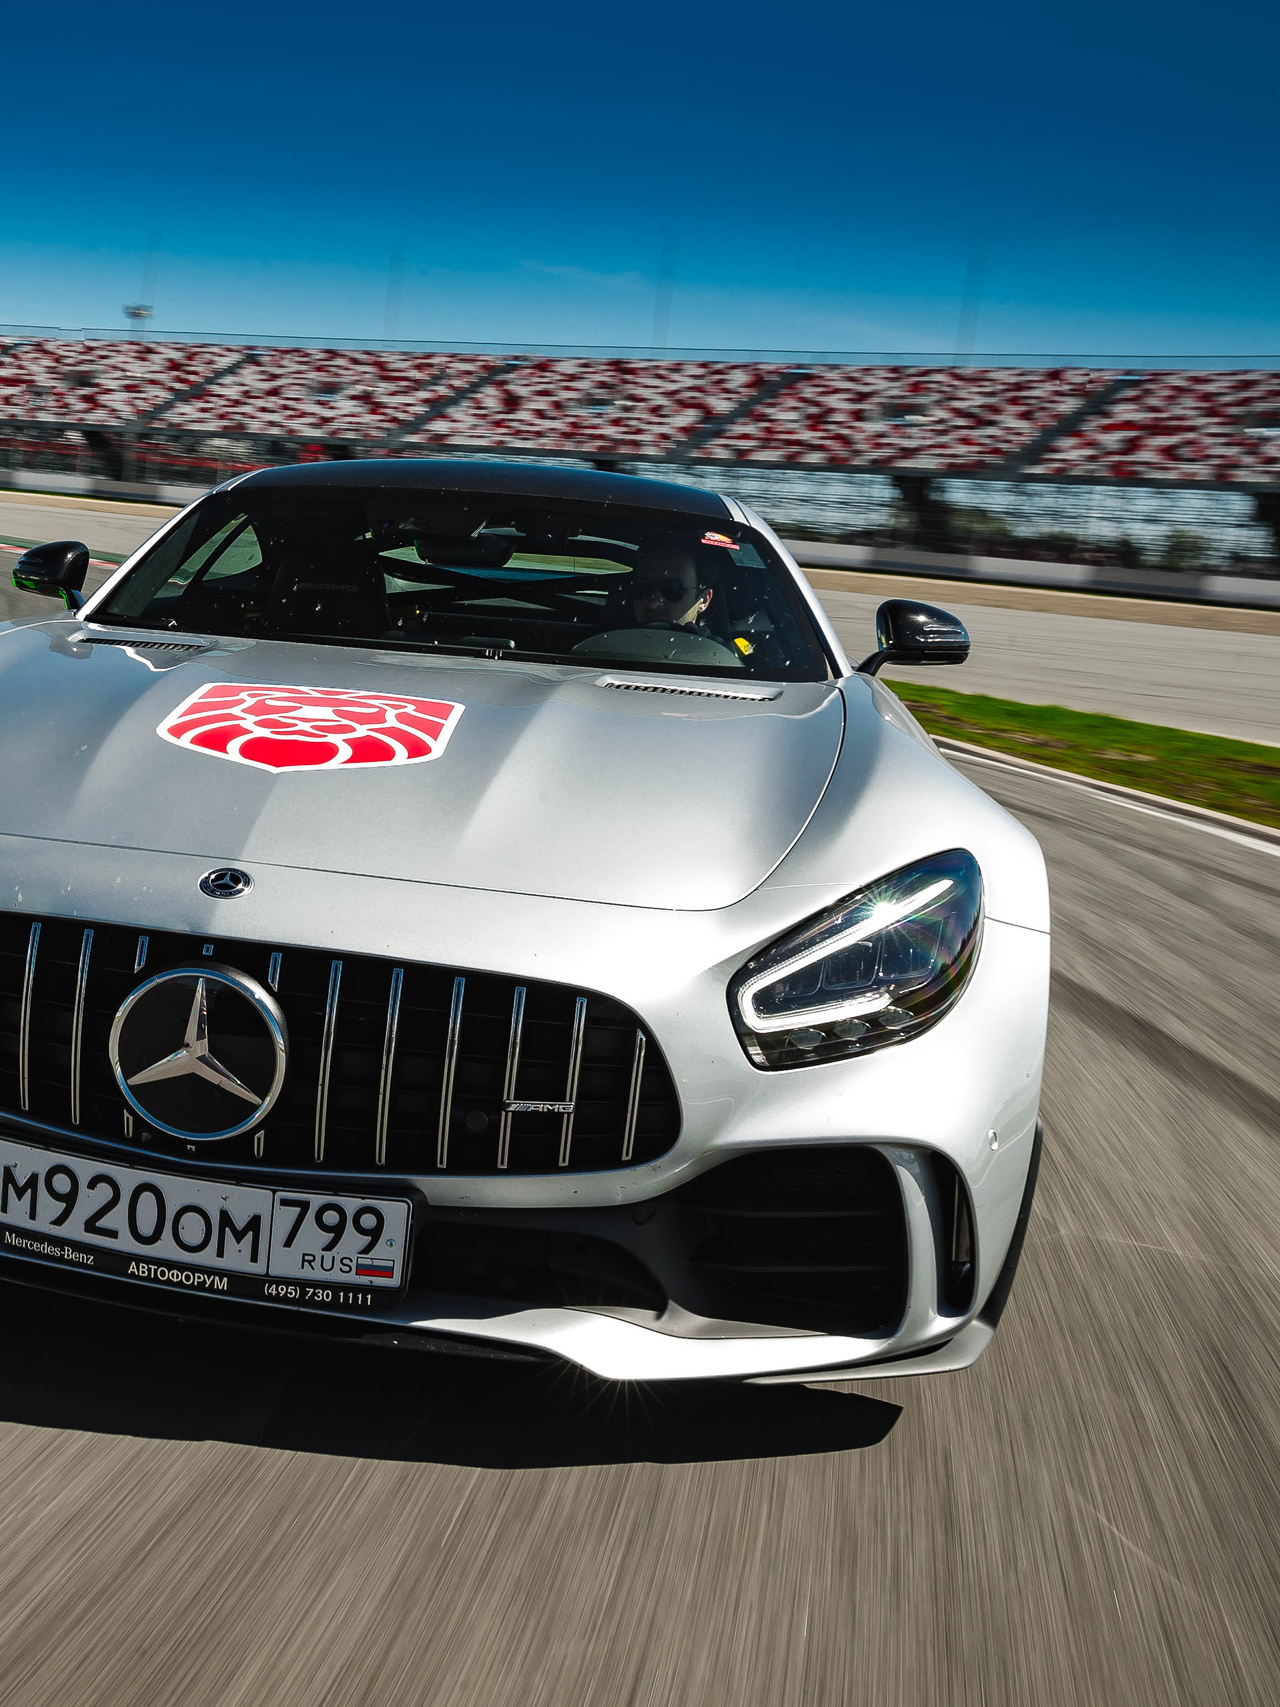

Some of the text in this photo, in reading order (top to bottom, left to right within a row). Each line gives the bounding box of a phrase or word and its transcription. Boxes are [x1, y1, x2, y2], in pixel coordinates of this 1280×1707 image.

[529, 1104, 574, 1112] AMG
[279, 1199, 385, 1255] 799
[4, 1231, 371, 1306] Mercedes-Benz АВТОФОРУМ (495) 730 1111
[301, 1253, 353, 1274] RUS
